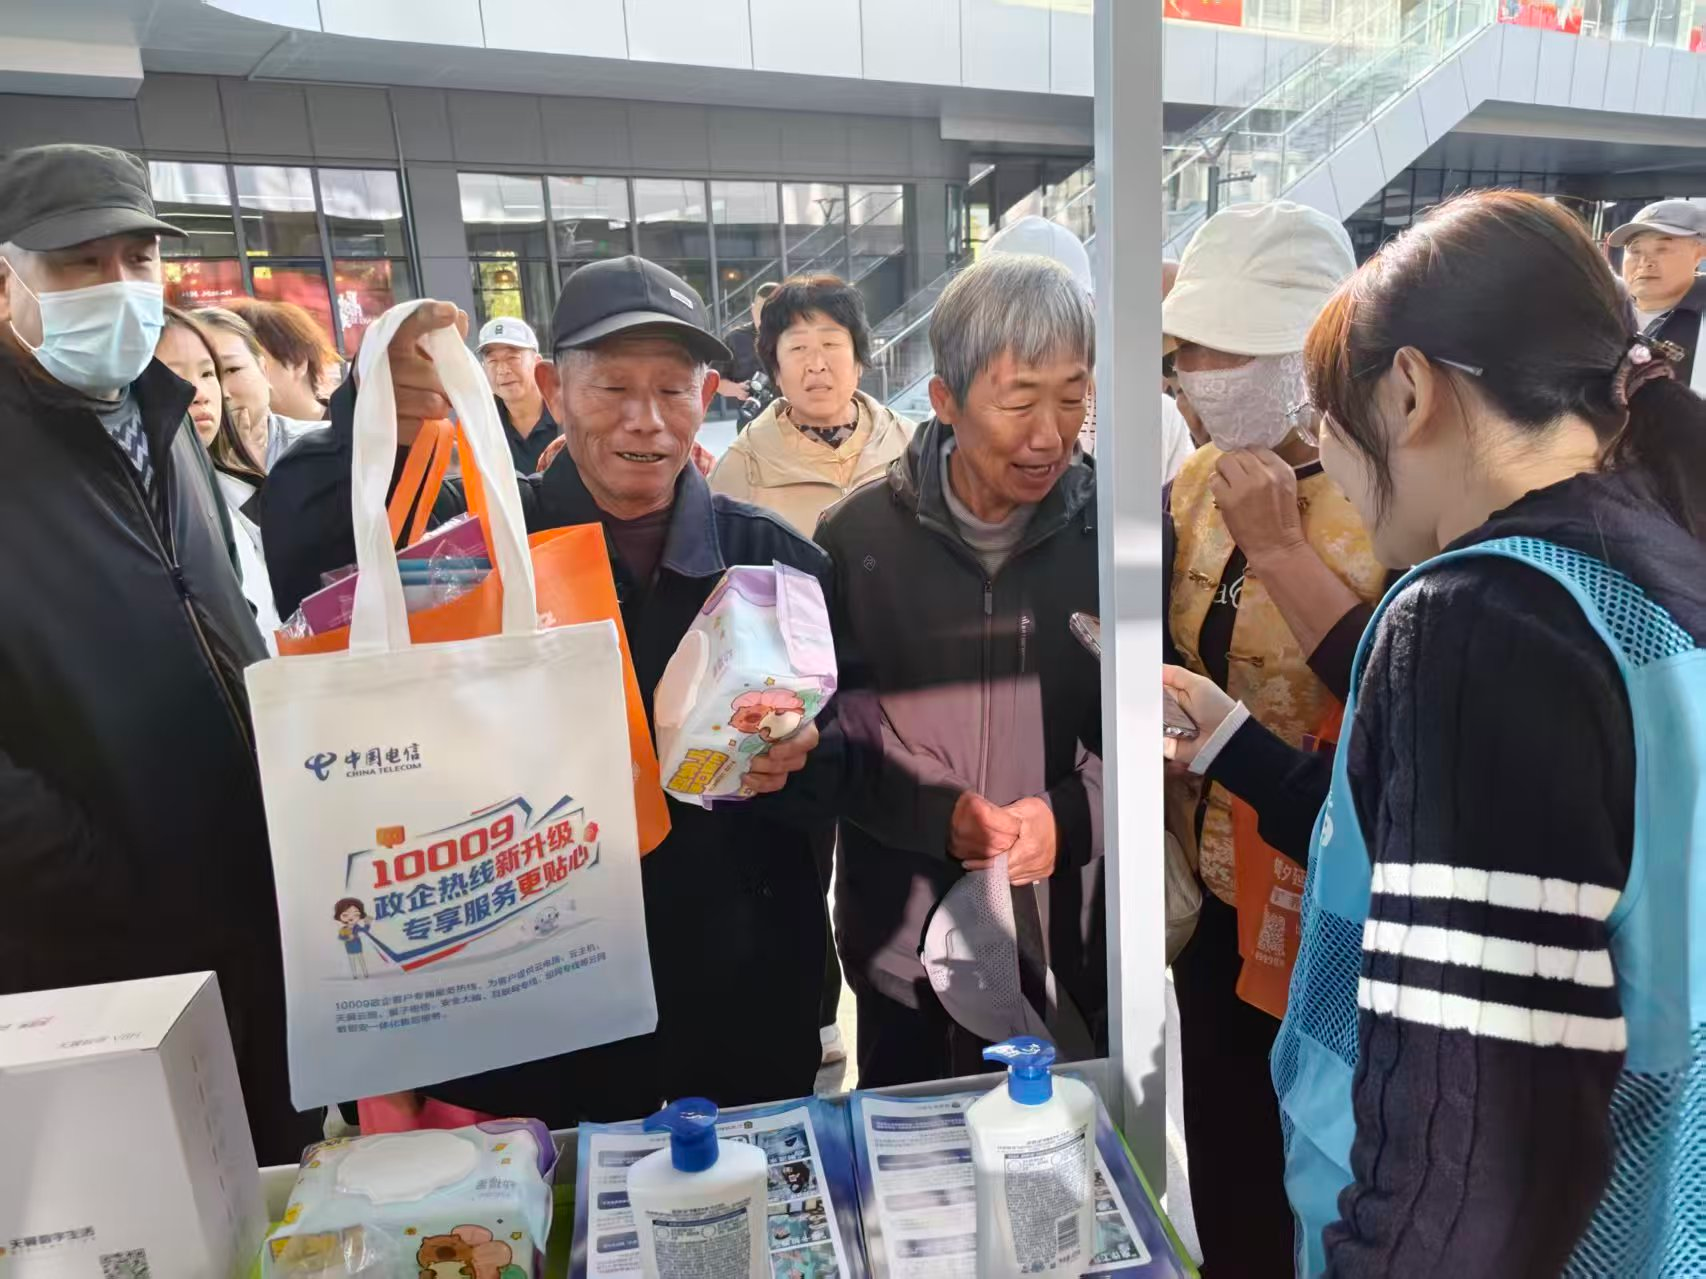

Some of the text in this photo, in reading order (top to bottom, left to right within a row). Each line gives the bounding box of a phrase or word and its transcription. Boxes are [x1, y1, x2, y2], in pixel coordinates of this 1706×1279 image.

[344, 742, 421, 770] 中国电信
[346, 763, 422, 778] CHINA TELECOM
[372, 814, 514, 889] 10009
[373, 819, 575, 921] 政企热线新升级
[402, 844, 589, 941] 专享服务更贴心
